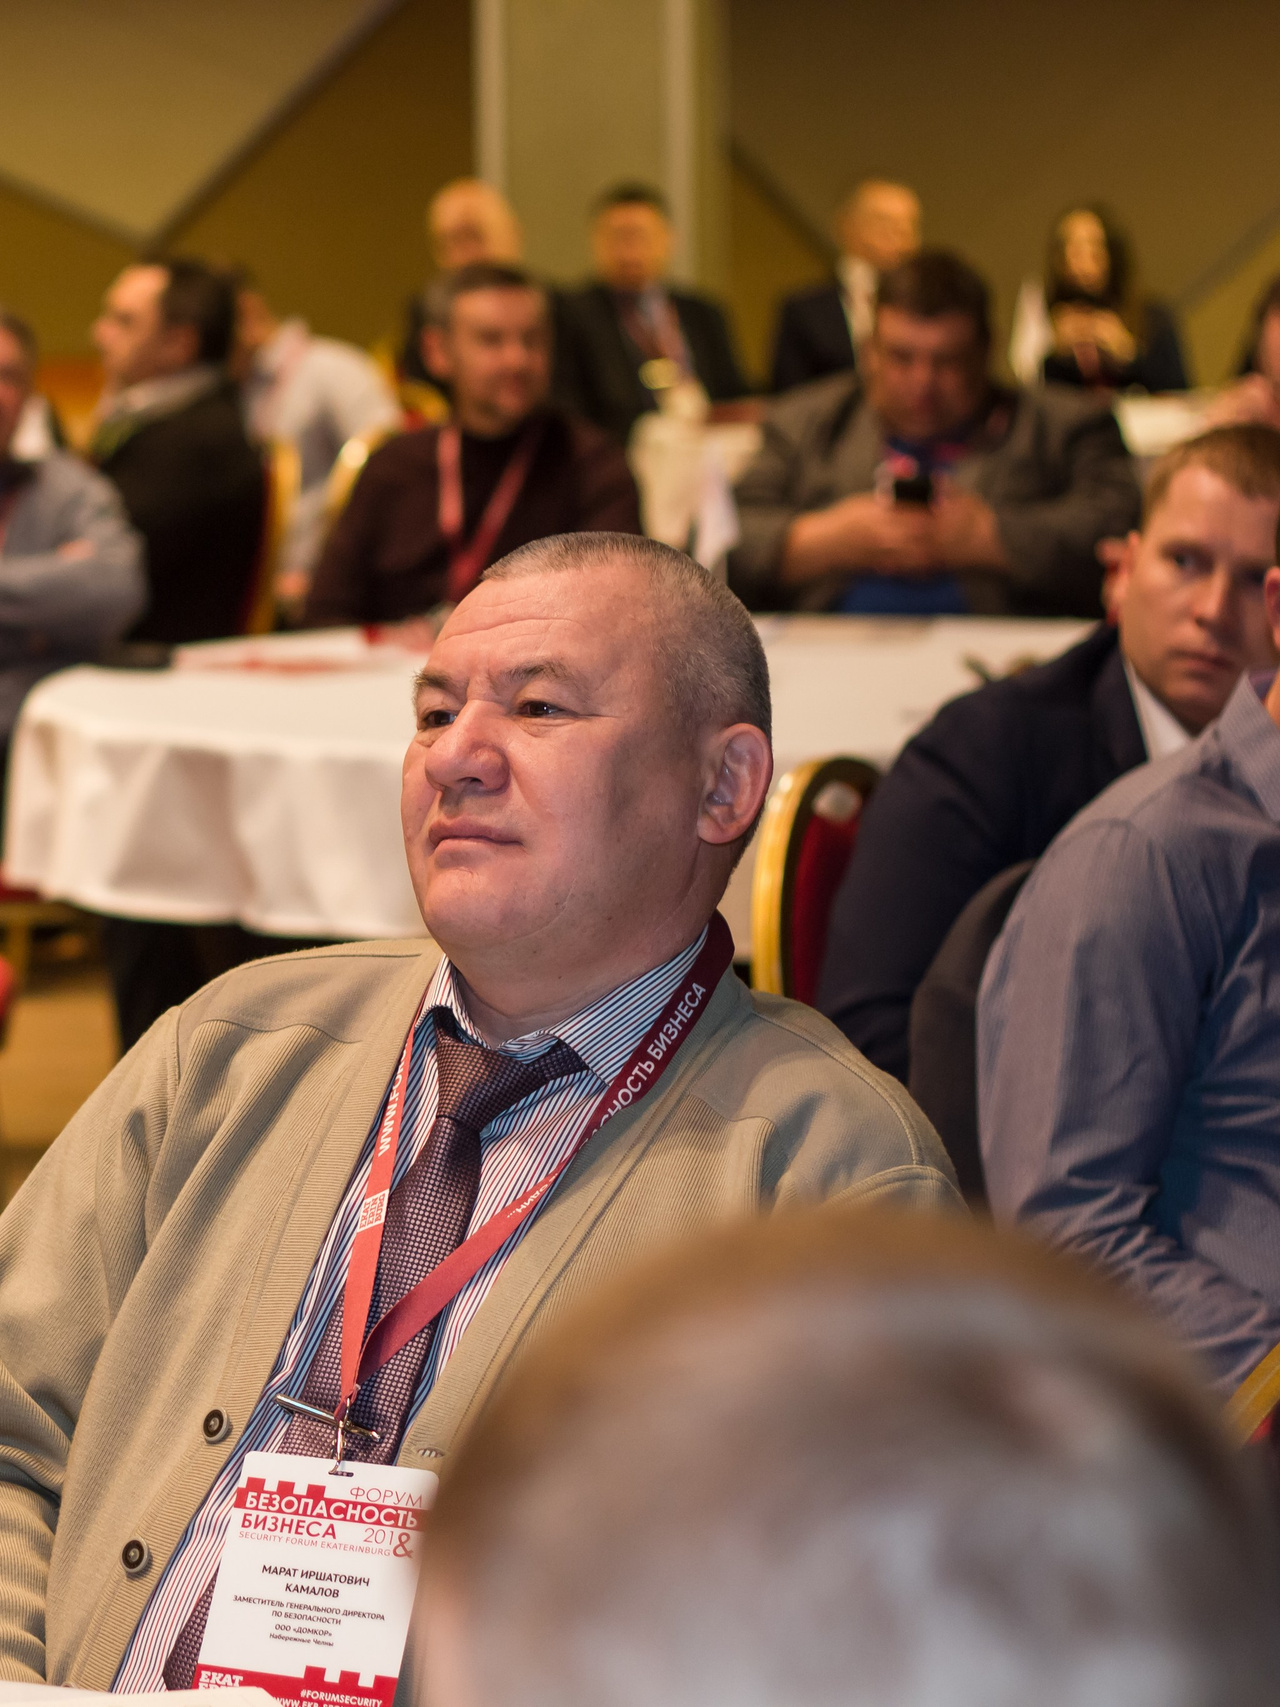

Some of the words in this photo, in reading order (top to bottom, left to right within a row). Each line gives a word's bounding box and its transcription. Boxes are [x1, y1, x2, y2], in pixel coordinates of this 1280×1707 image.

[647, 982, 706, 1061] БИЗНЕСА
[350, 1486, 422, 1508] ФОРУМ
[245, 1491, 417, 1528] БЕЗОПАСНОСТЬ
[241, 1513, 337, 1540] БИЗНЕСА
[238, 1530, 283, 1543] SECURITY
[285, 1537, 318, 1548] FORUM
[320, 1541, 391, 1557] EKATERINBURG
[261, 1564, 298, 1578] МАРАТ
[300, 1568, 371, 1587] ИРШАТОВИЧ
[284, 1583, 340, 1598] КАМАЛОВ
[233, 1594, 285, 1608] ЗАМЕСТИТЕЛЬ
[286, 1601, 341, 1615] ГЕНЕРАЛЬНОГО
[341, 1609, 385, 1621] ДИРЕКТОРА
[271, 1610, 283, 1618] ПО
[284, 1612, 342, 1625] БЕЗОПАСНОСТИ
[269, 1632, 311, 1644] Набережные
[274, 1623, 291, 1632] ООО
[293, 1626, 332, 1637] «ДОМКОР»
[199, 1670, 244, 1687] EKAT
[300, 1689, 382, 1707] #FORUMSECURITY
